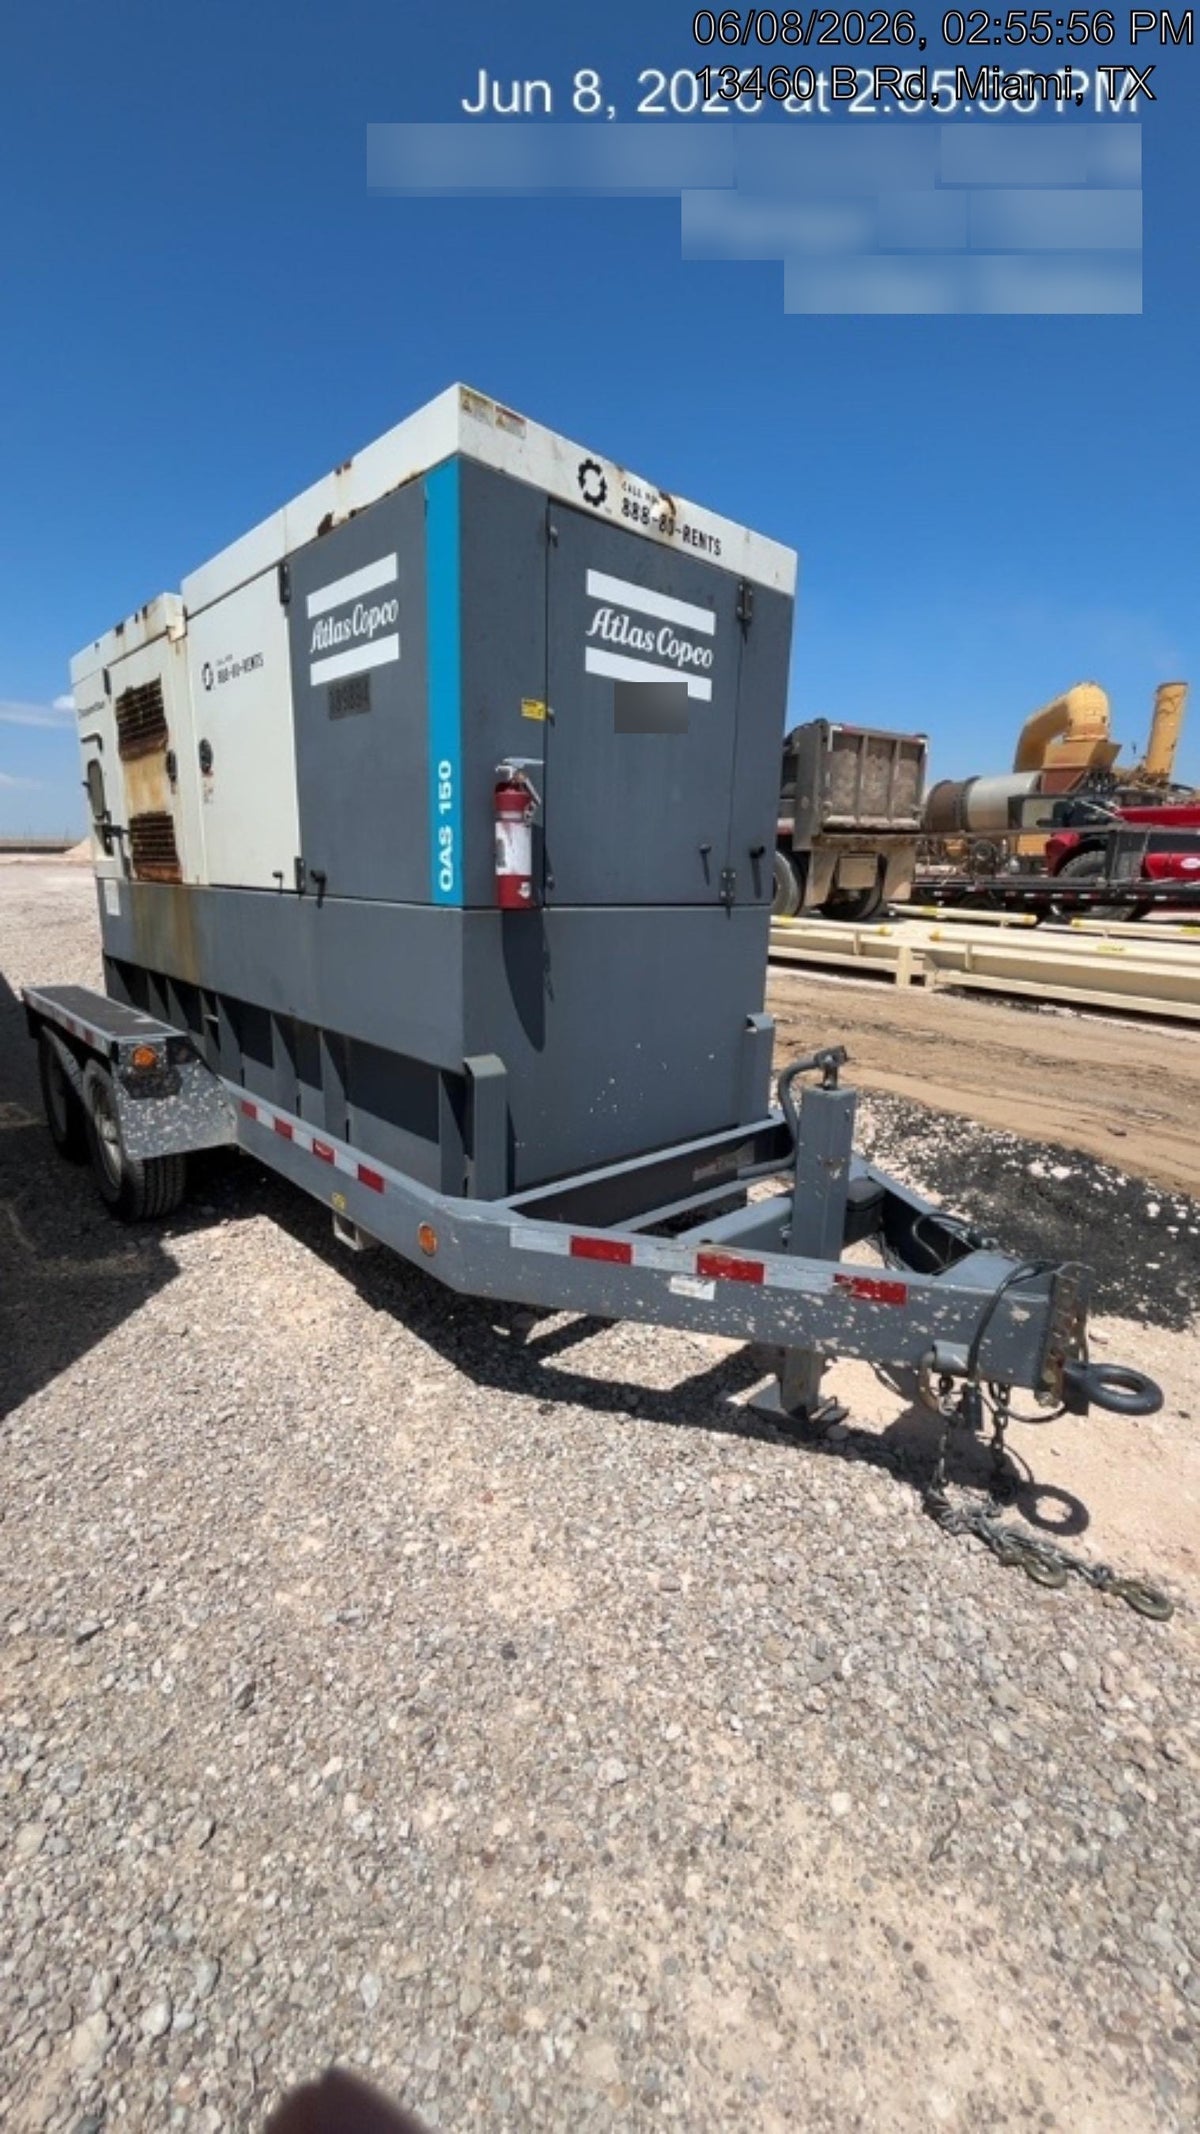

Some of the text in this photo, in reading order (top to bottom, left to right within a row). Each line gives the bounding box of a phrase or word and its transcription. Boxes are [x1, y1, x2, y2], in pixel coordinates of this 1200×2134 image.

[309, 598, 399, 654] Atlas Copco
[585, 606, 713, 669] Atlas Copco
[437, 759, 452, 815] 150
